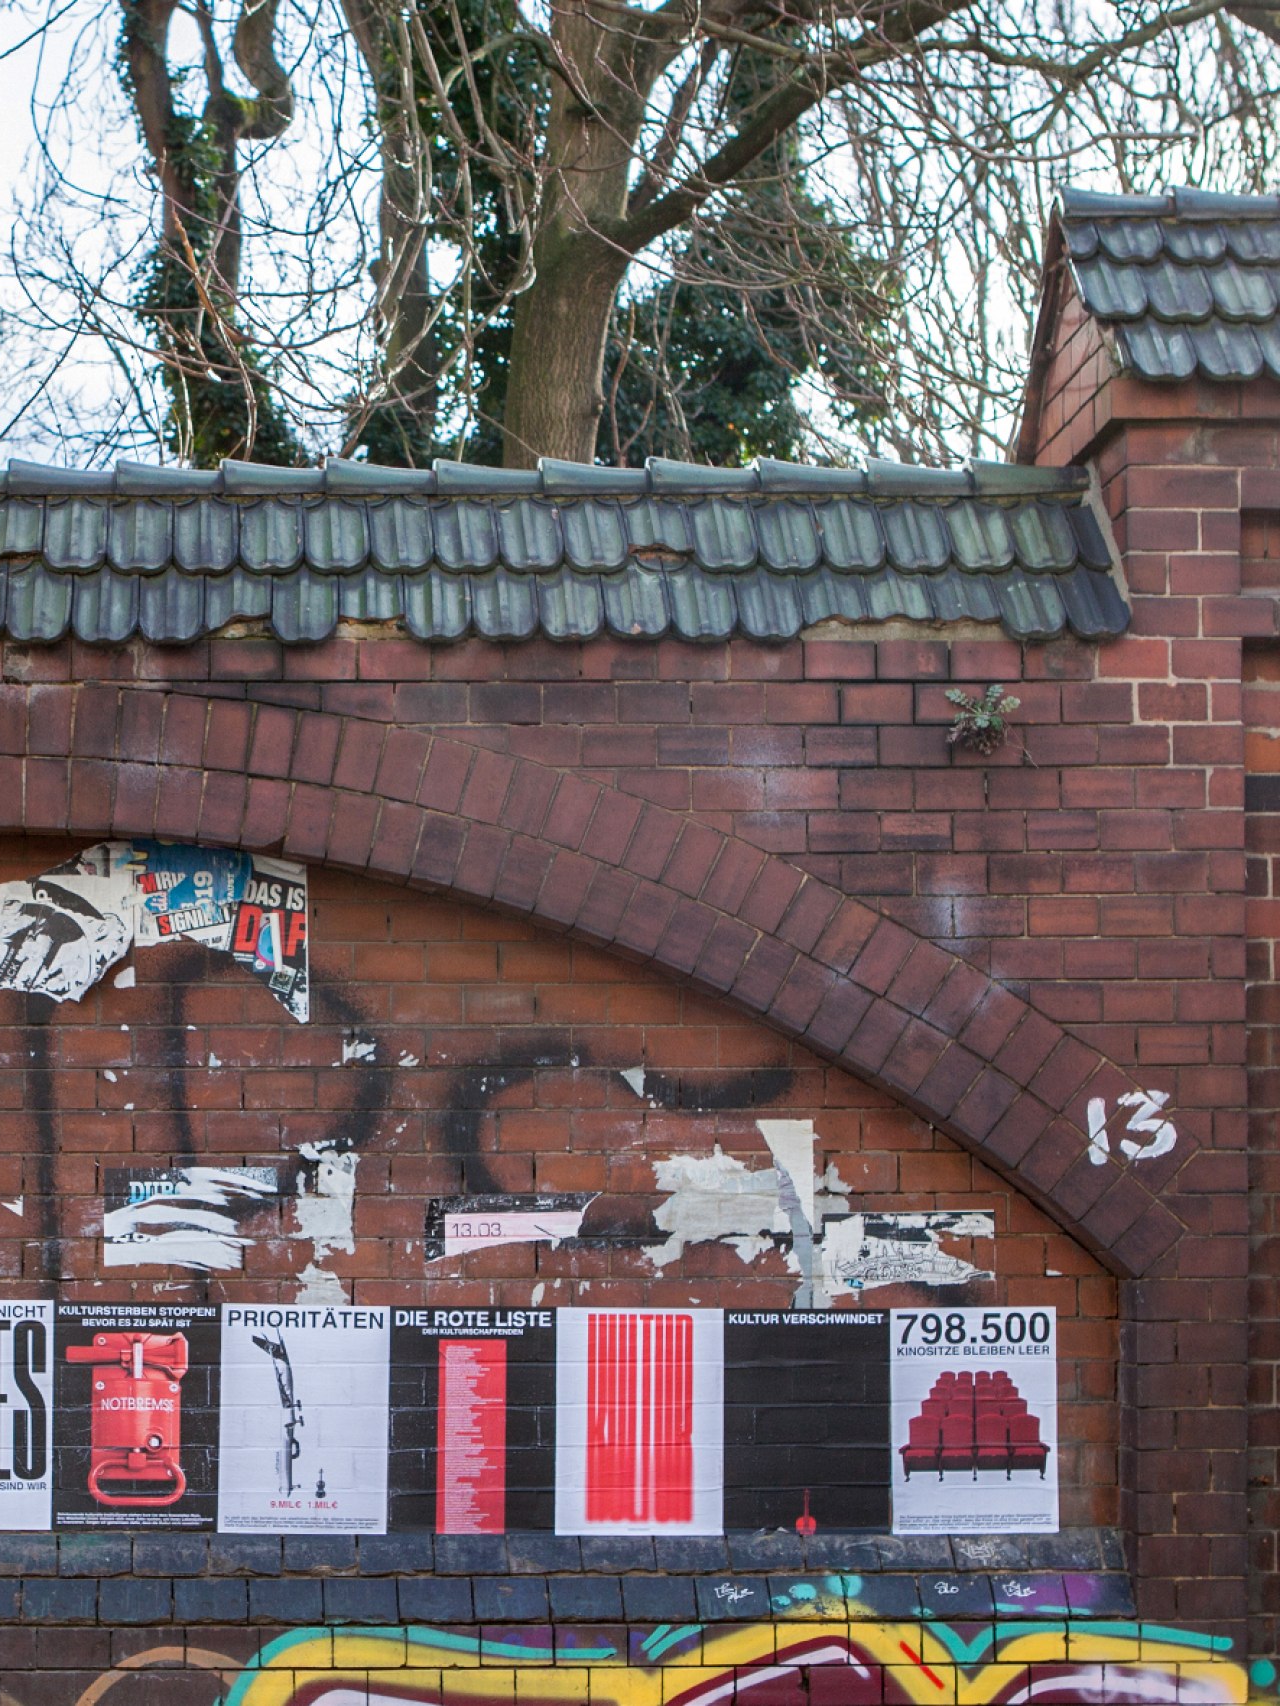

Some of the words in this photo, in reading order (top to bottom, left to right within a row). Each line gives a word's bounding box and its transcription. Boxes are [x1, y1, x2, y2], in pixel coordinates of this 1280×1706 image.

[244, 880, 282, 907] DAS
[1087, 1090, 1177, 1166] 13
[58, 1306, 156, 1317] KULTURSTERBEN
[159, 1306, 216, 1317] STOPPEN!
[228, 1307, 384, 1329] PRIORITÄTEN
[395, 1310, 428, 1326] DIE
[434, 1311, 489, 1327] ROTE
[495, 1311, 552, 1327] LISTE
[728, 1313, 779, 1324] KULTUR
[782, 1313, 884, 1324] VERSCHWINDET
[82, 1318, 116, 1327] BEVOR
[118, 1318, 131, 1327] ES
[133, 1318, 146, 1327] ZU
[148, 1317, 173, 1327] SPÄT
[176, 1319, 191, 1327] IST
[896, 1312, 1050, 1344] 798.500
[896, 1346, 959, 1356] KINOSITZE
[963, 1346, 1015, 1355] BLEIBEN
[1018, 1345, 1050, 1355] LEER
[0, 1482, 23, 1490] SIND
[27, 1482, 47, 1490] WIR
